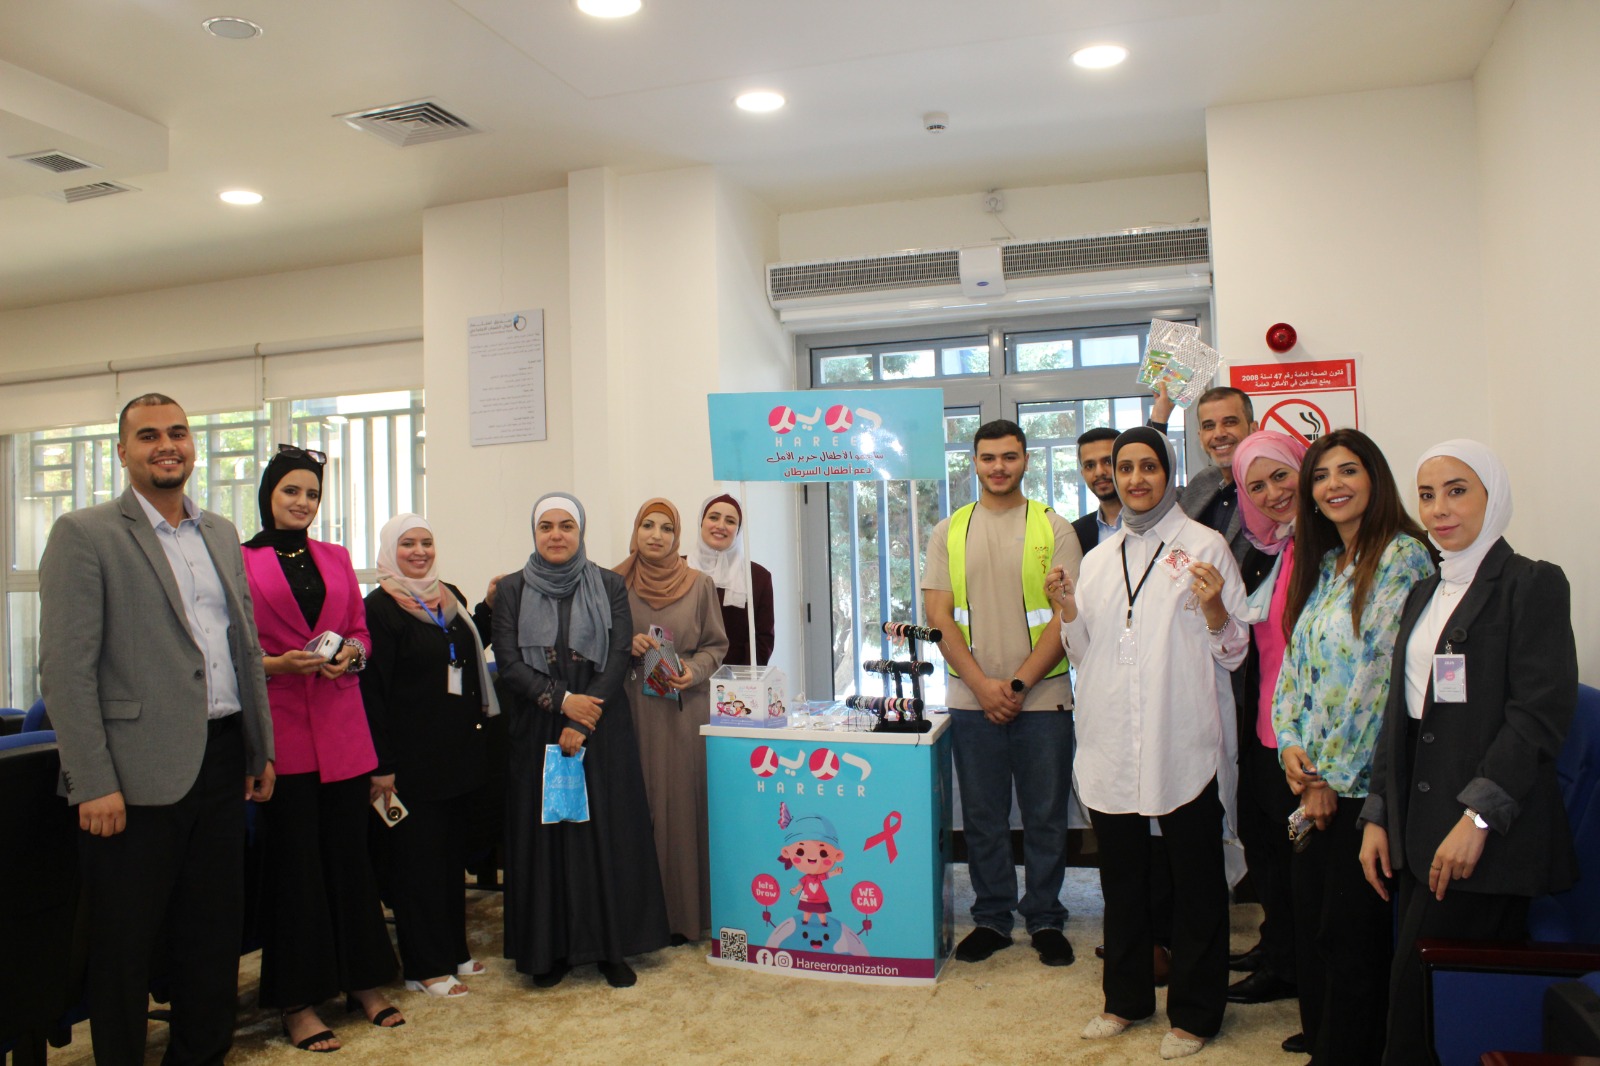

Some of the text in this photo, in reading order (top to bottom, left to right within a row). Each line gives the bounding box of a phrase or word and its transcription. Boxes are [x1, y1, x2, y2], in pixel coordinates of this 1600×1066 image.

[1283, 372, 1294, 380] رقم
[1311, 369, 1328, 377] الصحة
[1329, 368, 1344, 377] قانون
[1241, 374, 1259, 382] 2008
[1299, 378, 1318, 386] التدخين
[1271, 380, 1289, 388] الأماكن
[1290, 379, 1298, 388] في
[775, 435, 868, 447] HAREE
[766, 450, 794, 463] الأمل
[797, 453, 818, 463] حرير
[784, 464, 873, 478] دعم أطفال السرطان
[757, 780, 866, 797] HAREER
[755, 888, 777, 898] Draw
[858, 887, 875, 897] WE
[856, 896, 878, 907] CAN
[796, 957, 899, 975] Hareerorganization
